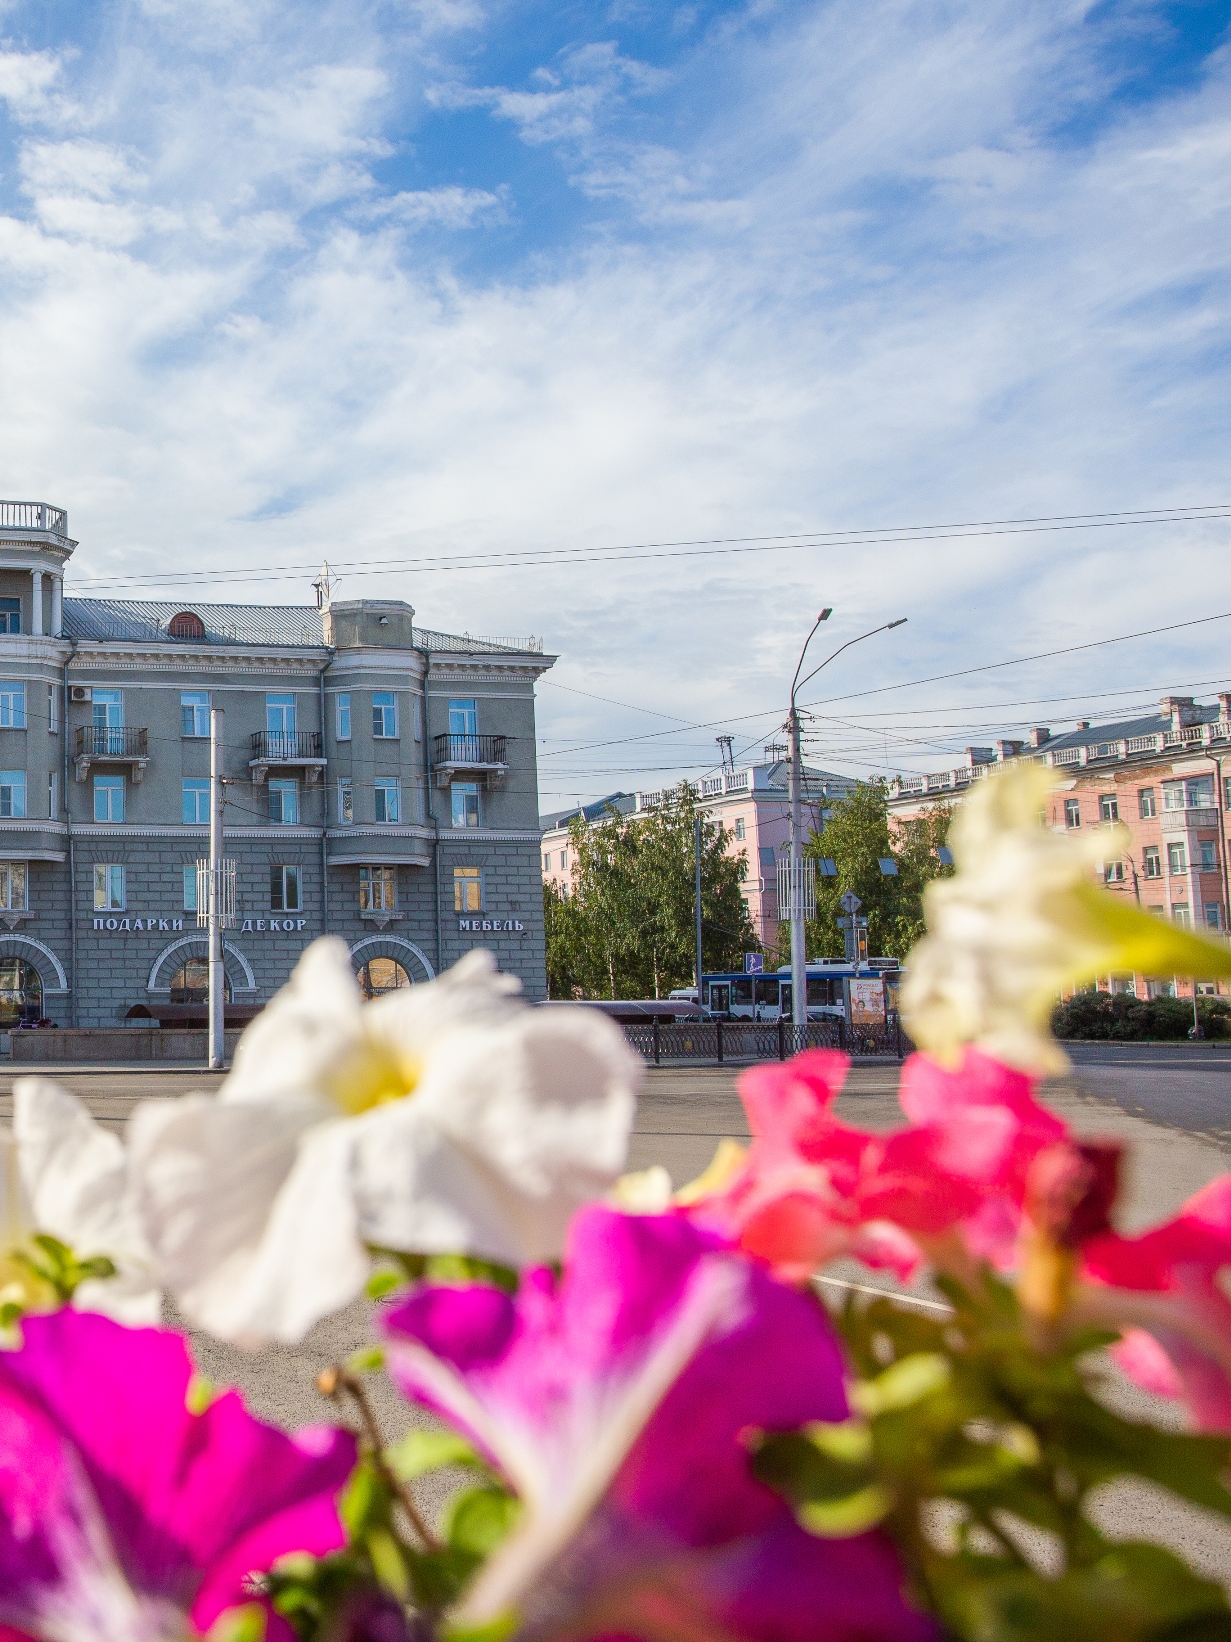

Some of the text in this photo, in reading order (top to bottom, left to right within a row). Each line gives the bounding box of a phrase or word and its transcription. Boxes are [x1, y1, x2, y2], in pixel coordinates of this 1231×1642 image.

[93, 918, 184, 932] ПОДАРКИ
[240, 919, 307, 933] ДЕКОР
[459, 920, 524, 931] МЕБЕЛЬ
